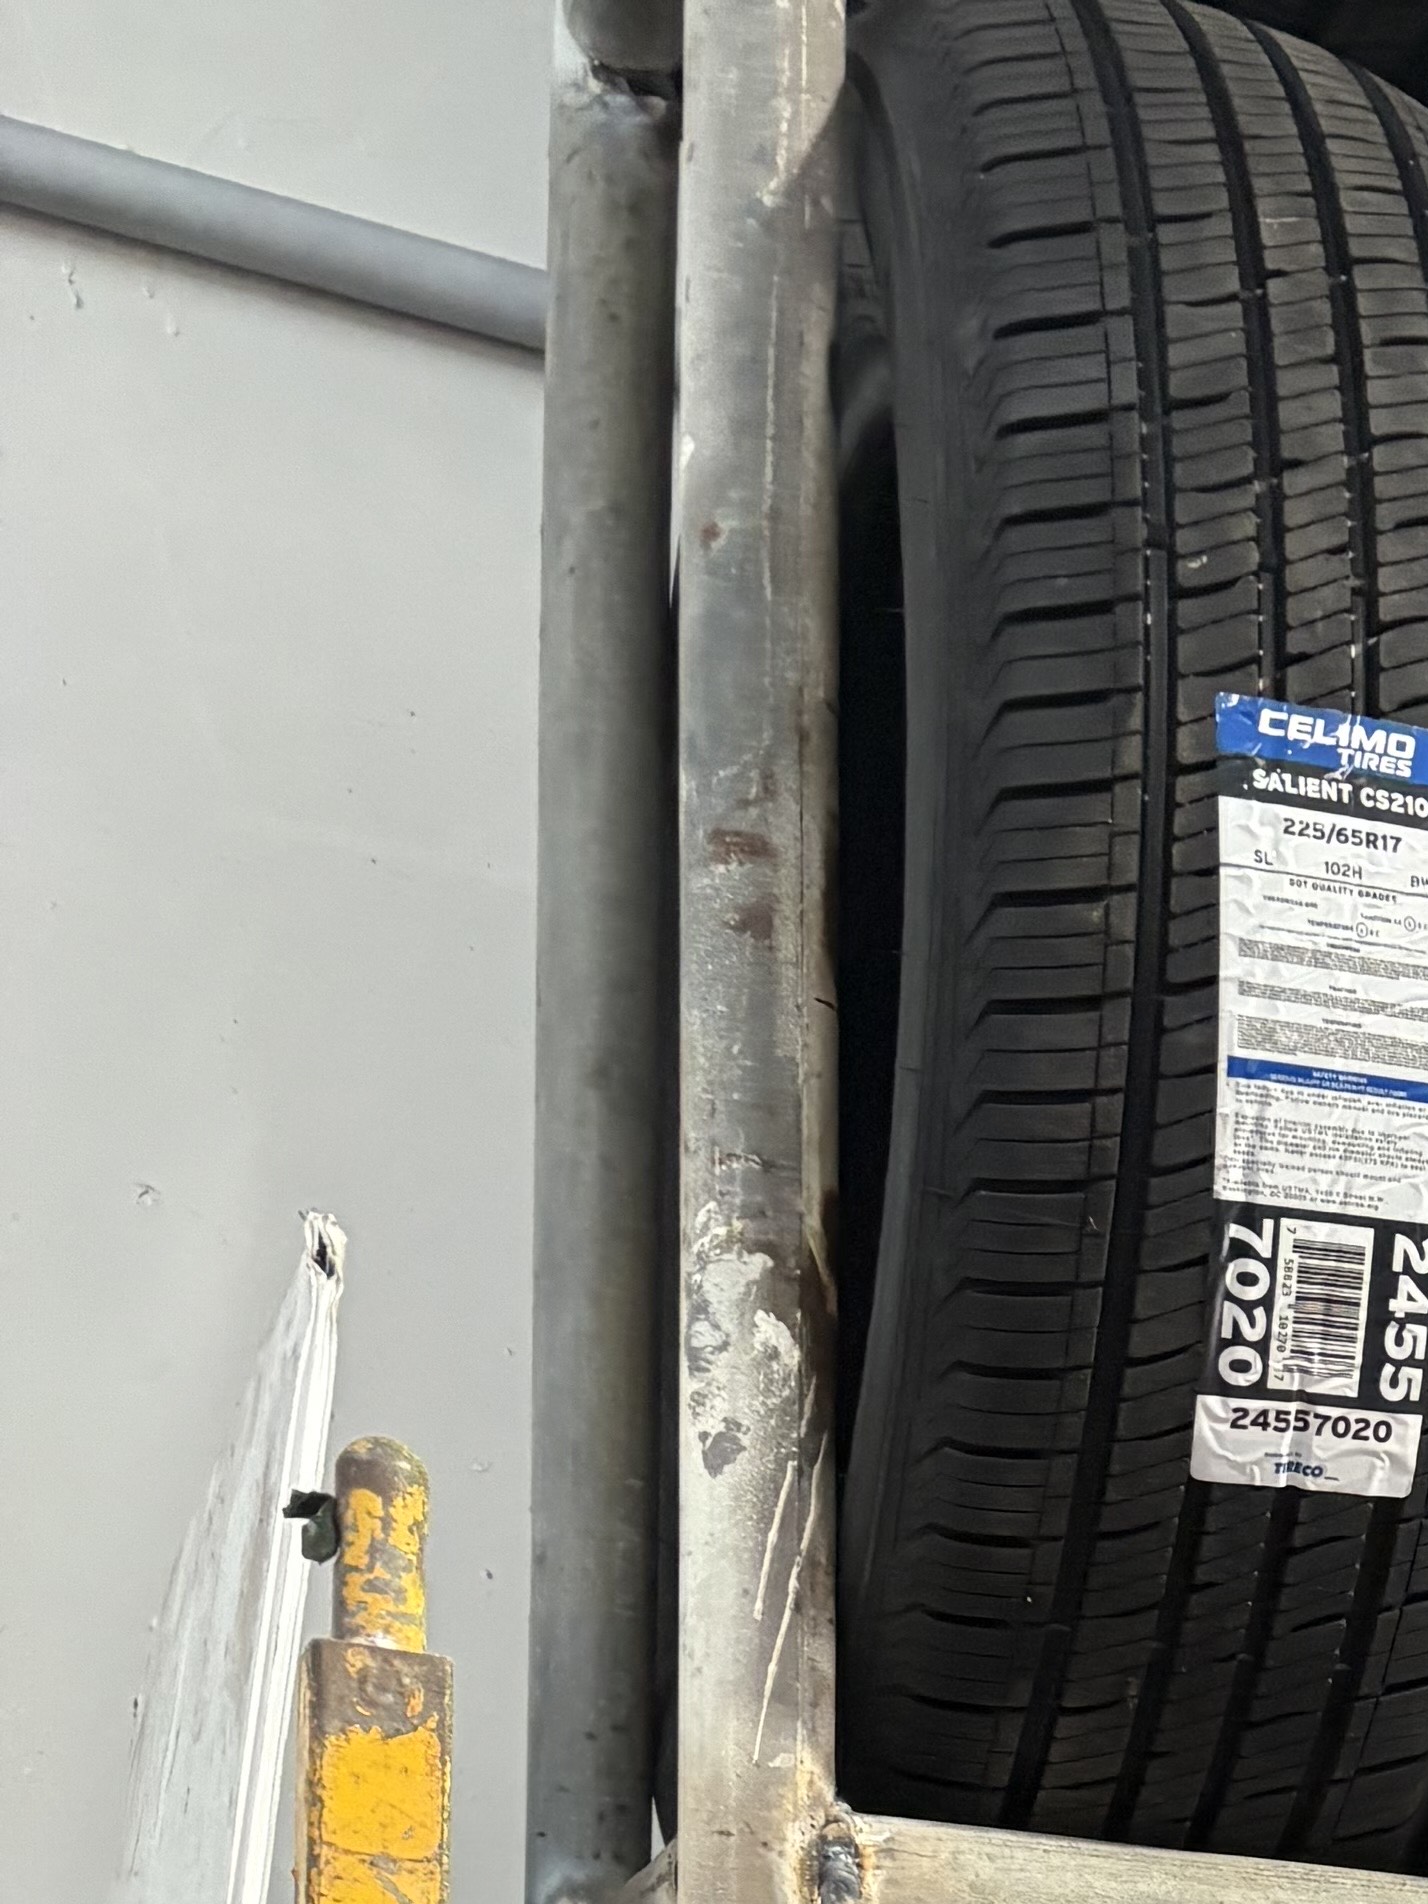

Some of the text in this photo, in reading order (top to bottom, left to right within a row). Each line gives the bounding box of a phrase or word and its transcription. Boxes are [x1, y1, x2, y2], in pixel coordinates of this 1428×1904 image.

[1257, 709, 1416, 759] CELIMO
[1338, 747, 1412, 778] TIRES
[1252, 768, 1353, 805] SALIENT
[1283, 817, 1402, 854] 225/65R17
[1253, 849, 1274, 866] SL
[1324, 860, 1363, 880] 102H
[1218, 1218, 1274, 1387] 7020
[1229, 1407, 1393, 1443] 24557020
[1273, 1461, 1323, 1480] TIRECO
